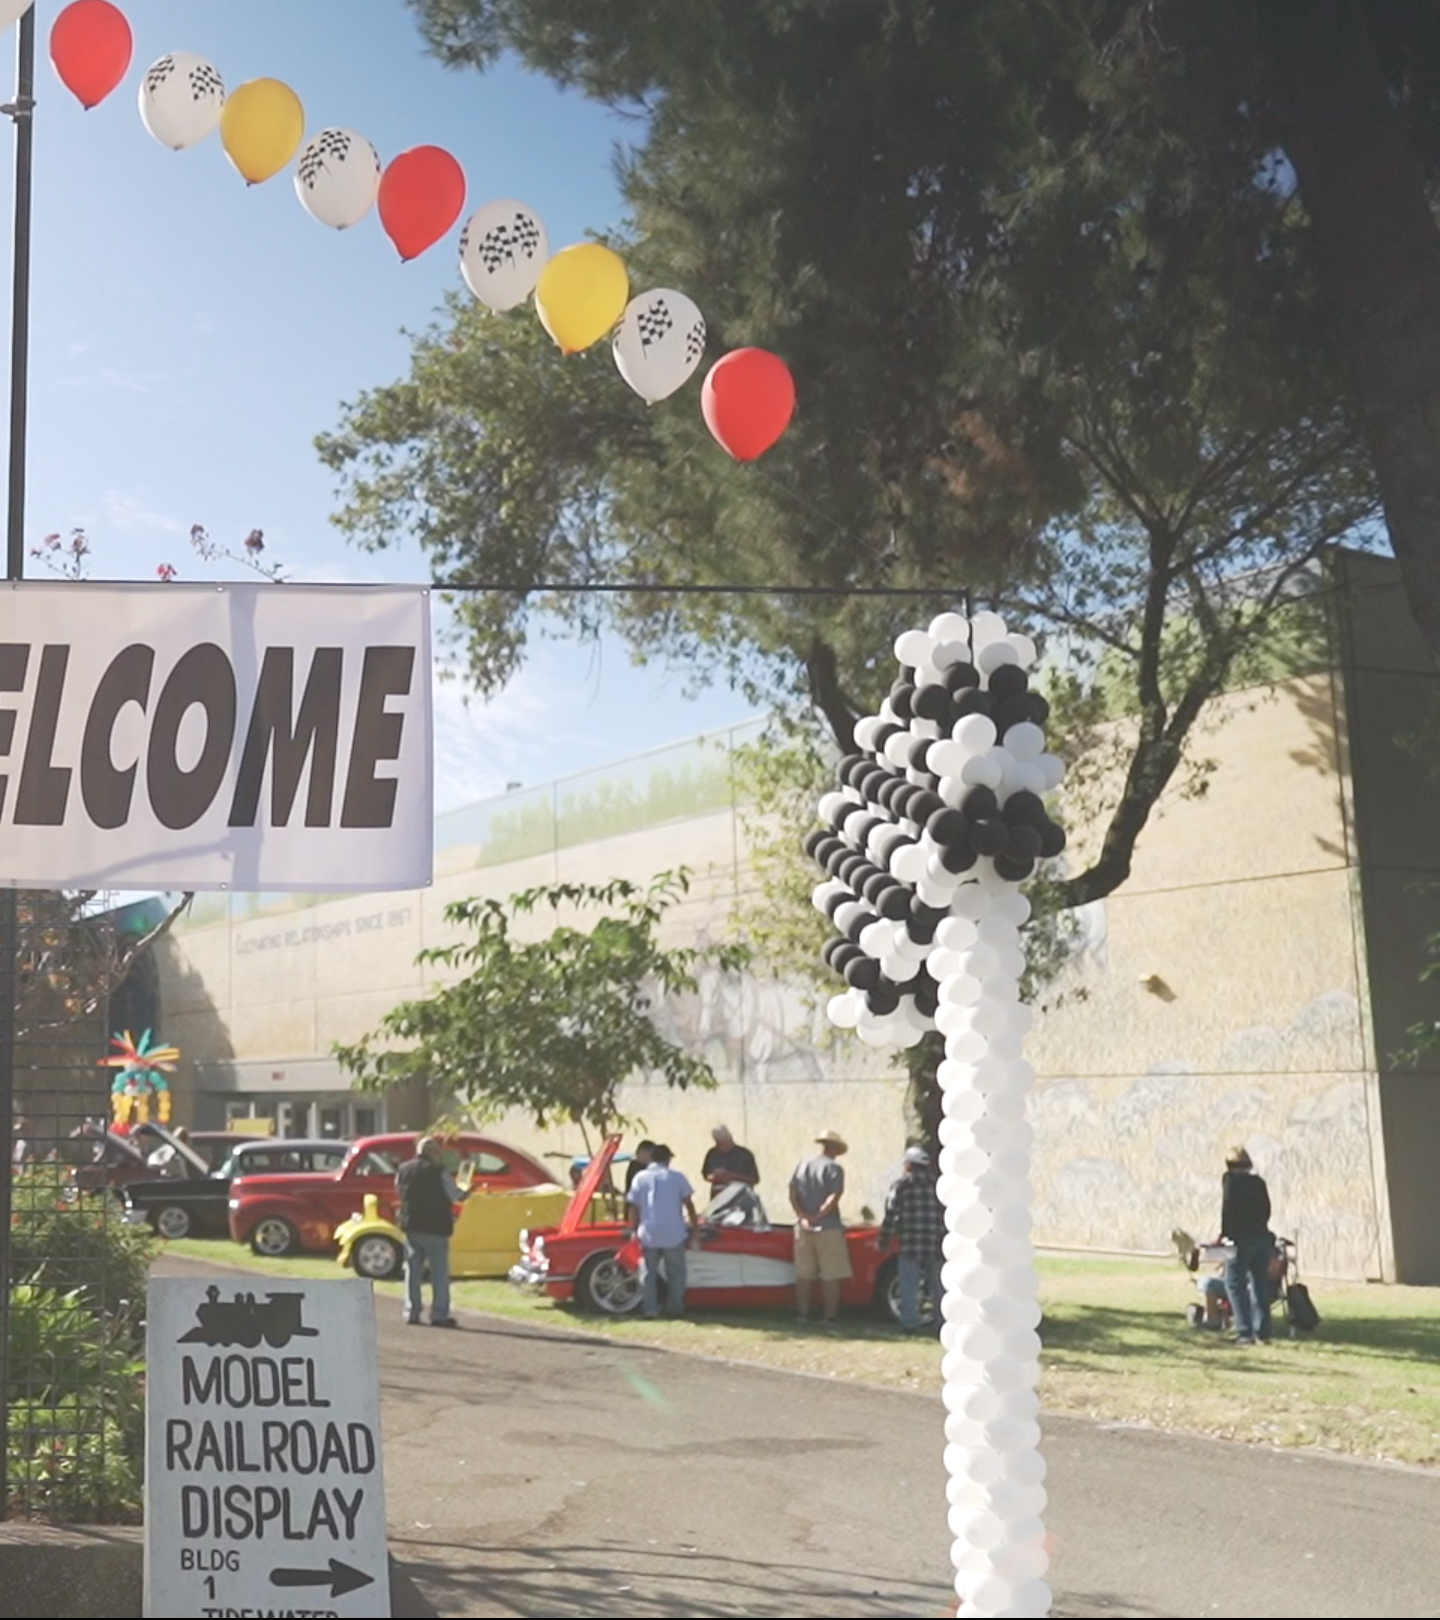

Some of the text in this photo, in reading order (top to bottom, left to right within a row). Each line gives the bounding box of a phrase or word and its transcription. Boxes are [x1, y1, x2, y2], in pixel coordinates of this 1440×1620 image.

[182, 1354, 331, 1408] MODEL
[166, 1419, 375, 1475] RAILROAD
[181, 1485, 363, 1540] DISPLAY
[180, 1549, 240, 1572] BLDG
[204, 1575, 216, 1600] 1
